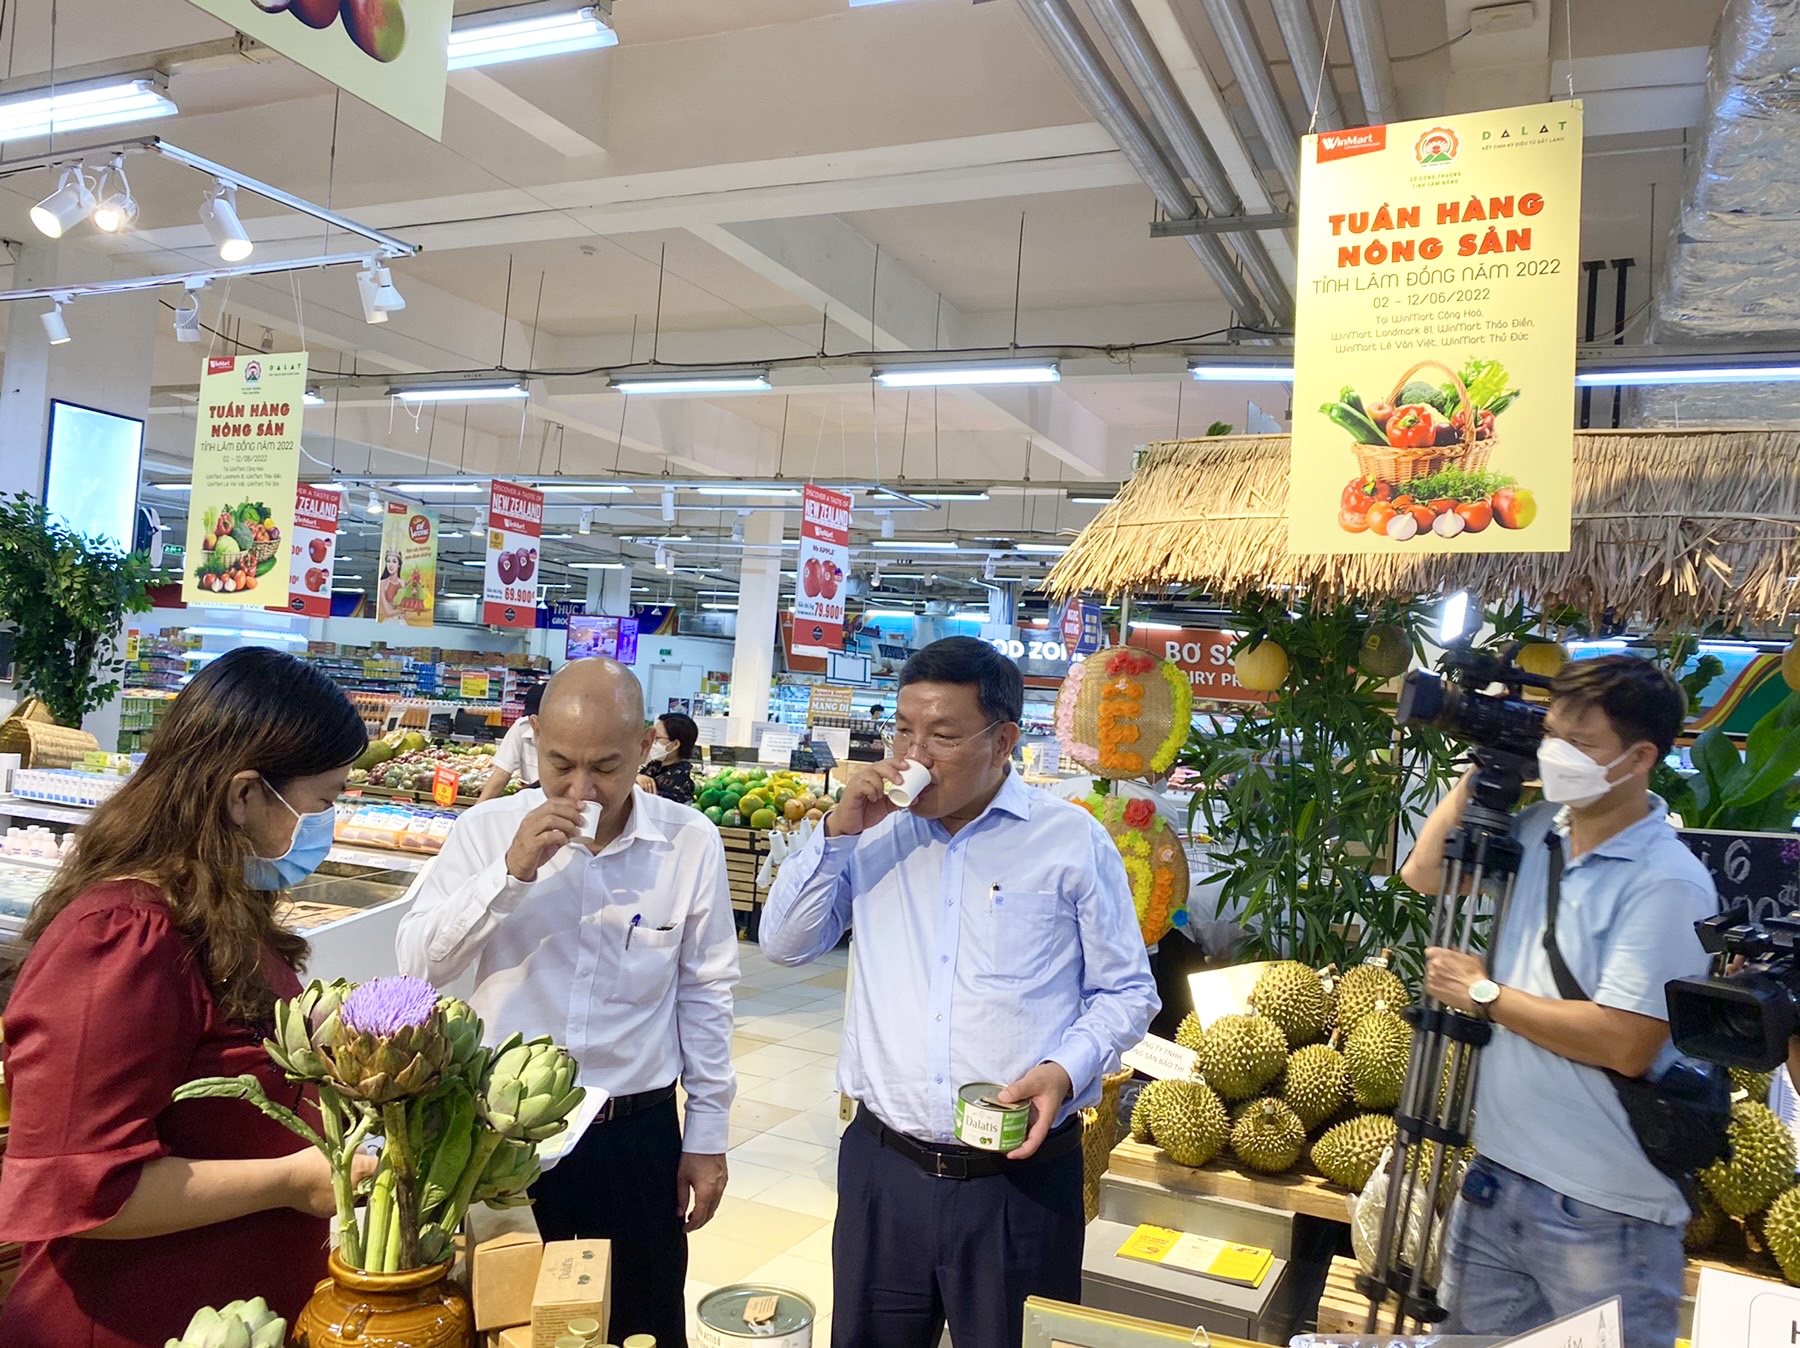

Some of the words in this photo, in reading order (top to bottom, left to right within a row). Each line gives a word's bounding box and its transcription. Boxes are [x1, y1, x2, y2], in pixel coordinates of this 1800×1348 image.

[1321, 133, 1374, 151] WinMart
[1328, 202, 1421, 237] TUẦN
[1436, 192, 1545, 226] HÀNG
[1337, 237, 1444, 268] NÔNG
[1457, 225, 1532, 257] SẢN
[1312, 273, 1349, 295] TỈNH
[1355, 272, 1399, 291] LÂM
[1406, 265, 1456, 287] ĐỒNG
[1461, 262, 1509, 282] NĂM
[1516, 258, 1562, 278] 2022
[1373, 296, 1390, 309] 02
[1406, 288, 1491, 306] 12/06/2022
[1376, 315, 1390, 325] Tại
[1391, 312, 1435, 324] WinMart
[1331, 330, 1373, 341] WinMart
[1375, 326, 1421, 338] Landmark
[1423, 325, 1435, 335] 81,
[1437, 321, 1482, 333] WinMart
[1335, 343, 1378, 354] WinMart
[1380, 341, 1392, 351] Lê
[1441, 336, 1486, 347] WinMart
[1510, 331, 1530, 342] Đức
[250, 401, 290, 418] HÀNG
[211, 422, 252, 438] NÔNG
[256, 419, 285, 437] SẢN
[276, 440, 294, 451] 2022
[313, 490, 330, 499] TASTE
[300, 496, 338, 517] ZEALAND
[493, 492, 510, 512] NEW
[510, 497, 542, 520] ZEALAND
[805, 498, 820, 520] NEW
[820, 503, 849, 527] ZEALAND
[819, 546, 835, 556] APPLE
[552, 617, 569, 626] GROC
[991, 639, 1025, 658] OD
[1165, 641, 1201, 665] BƠ
[1189, 670, 1216, 686] IRY
[812, 701, 838, 712] MANG
[1163, 1047, 1183, 1060] TNHH
[966, 1115, 998, 1133] Dalatis
